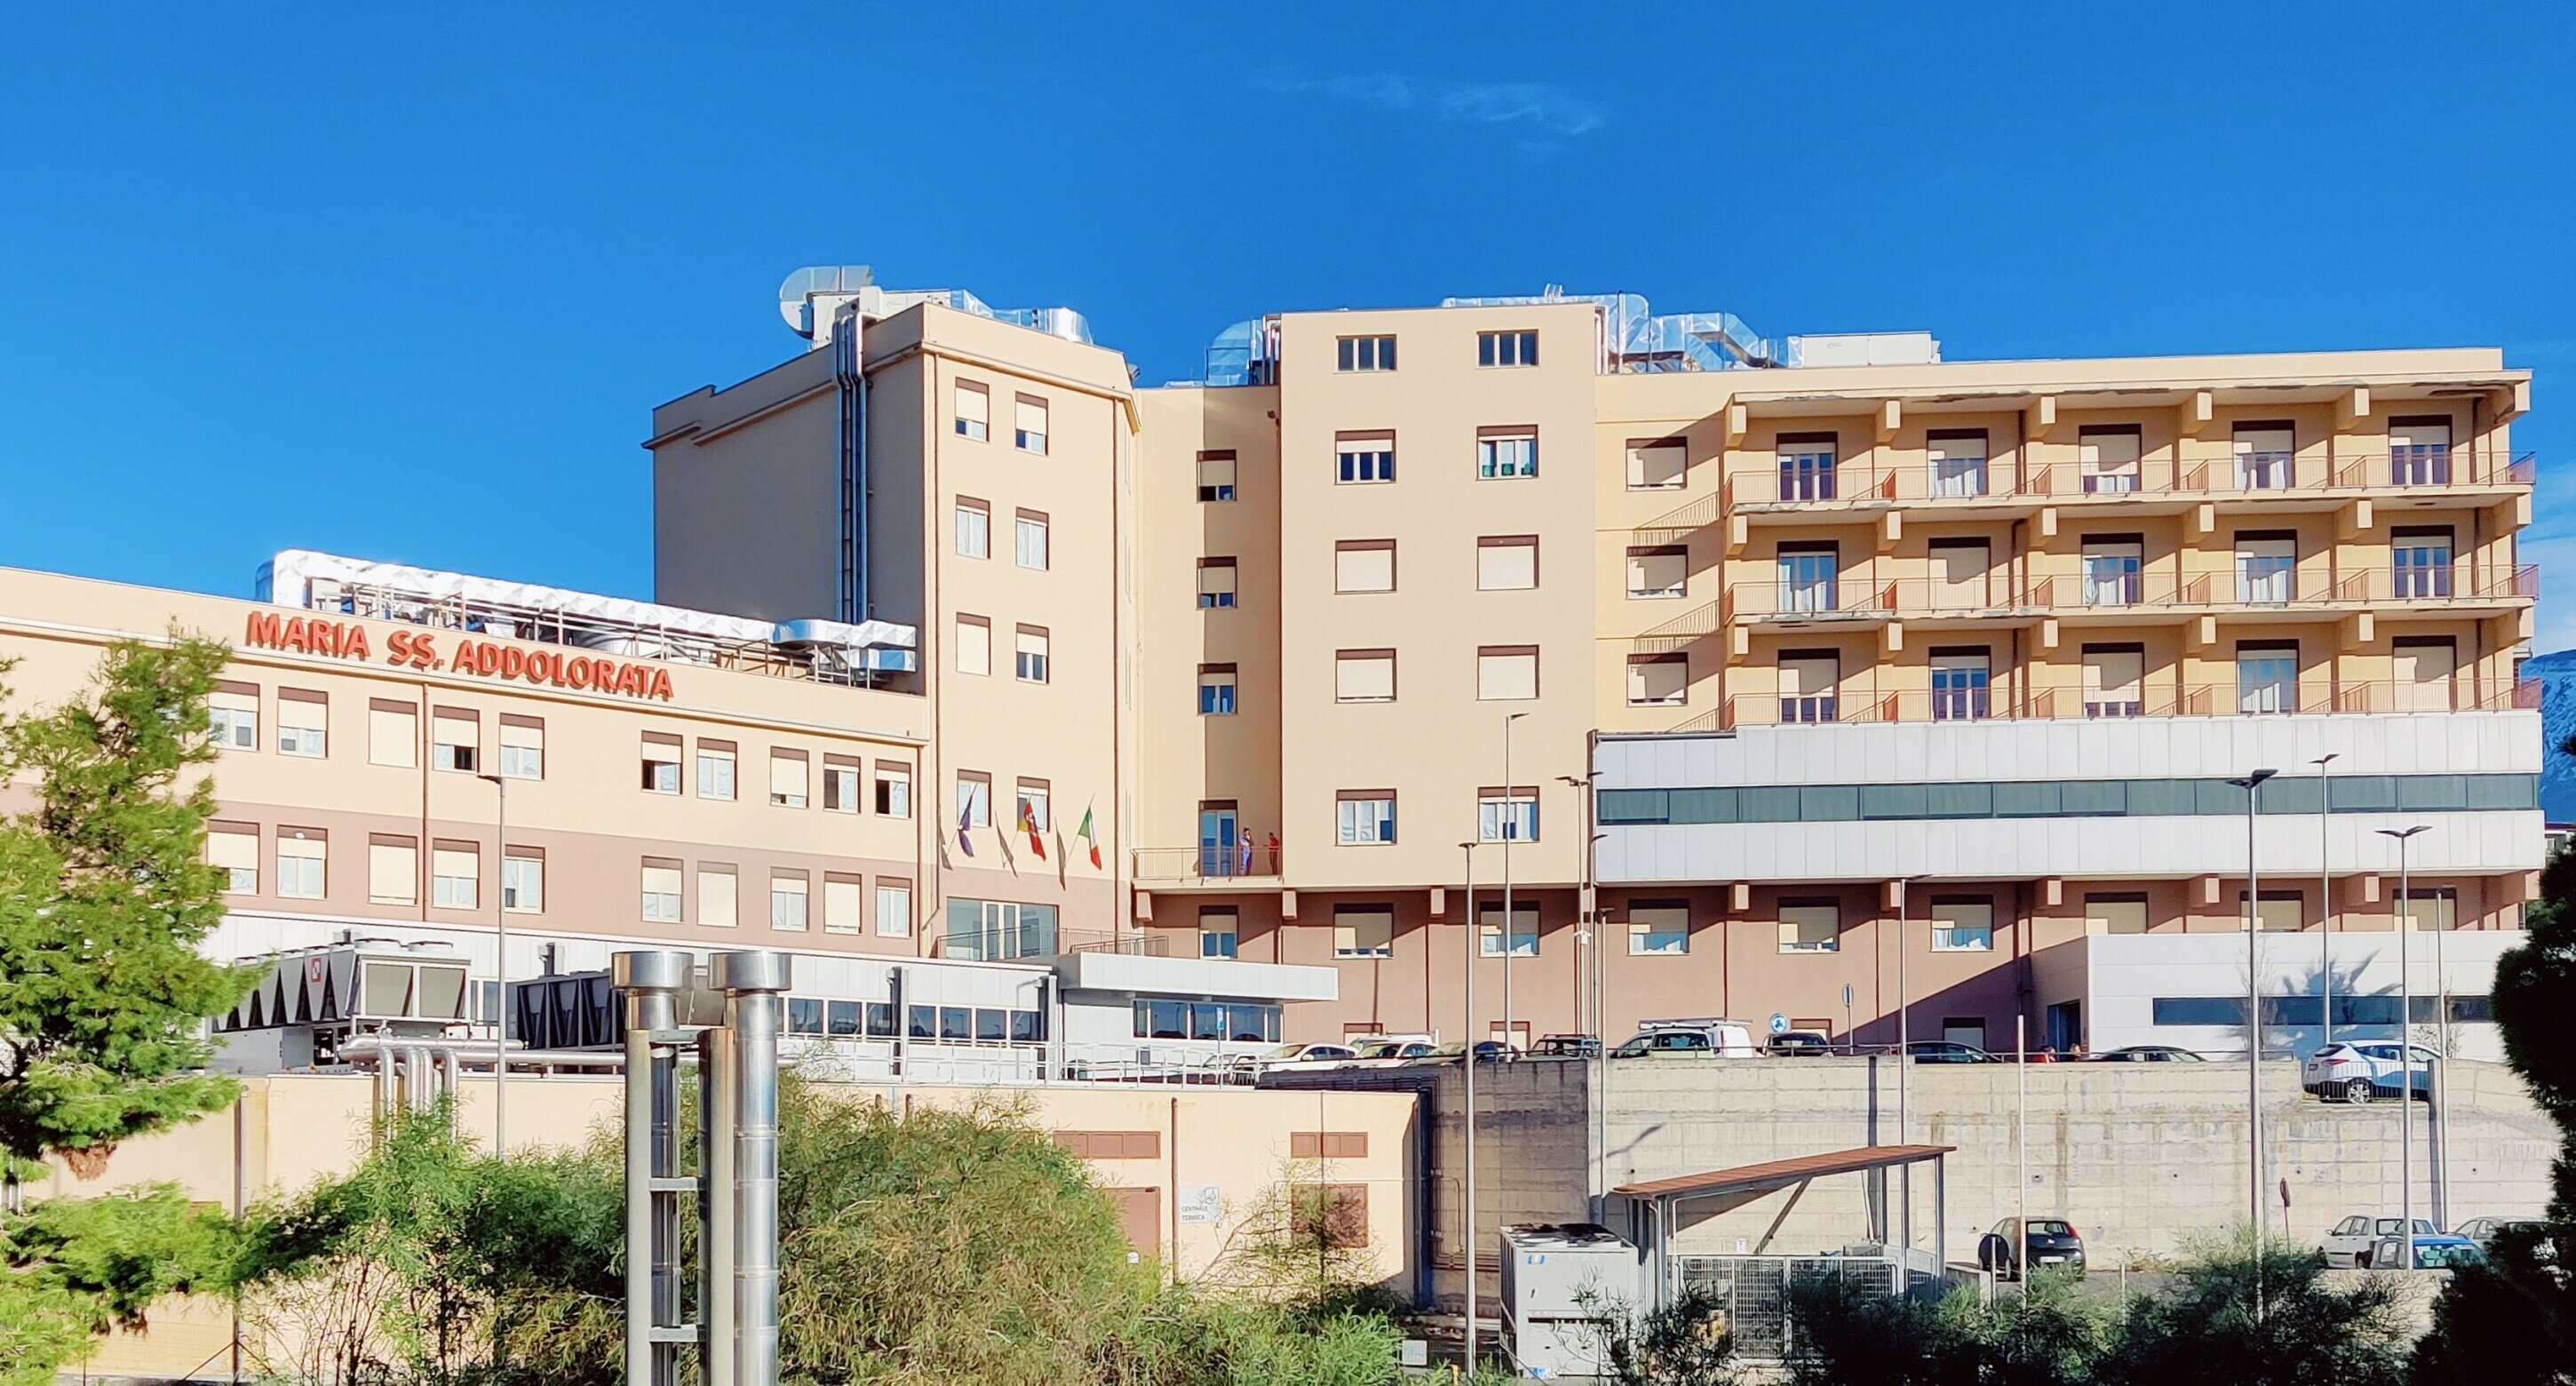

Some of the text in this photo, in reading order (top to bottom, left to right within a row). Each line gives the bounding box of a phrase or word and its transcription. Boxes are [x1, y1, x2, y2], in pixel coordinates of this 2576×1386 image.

[246, 610, 674, 700] MARIA SS. ADDOLORATA
